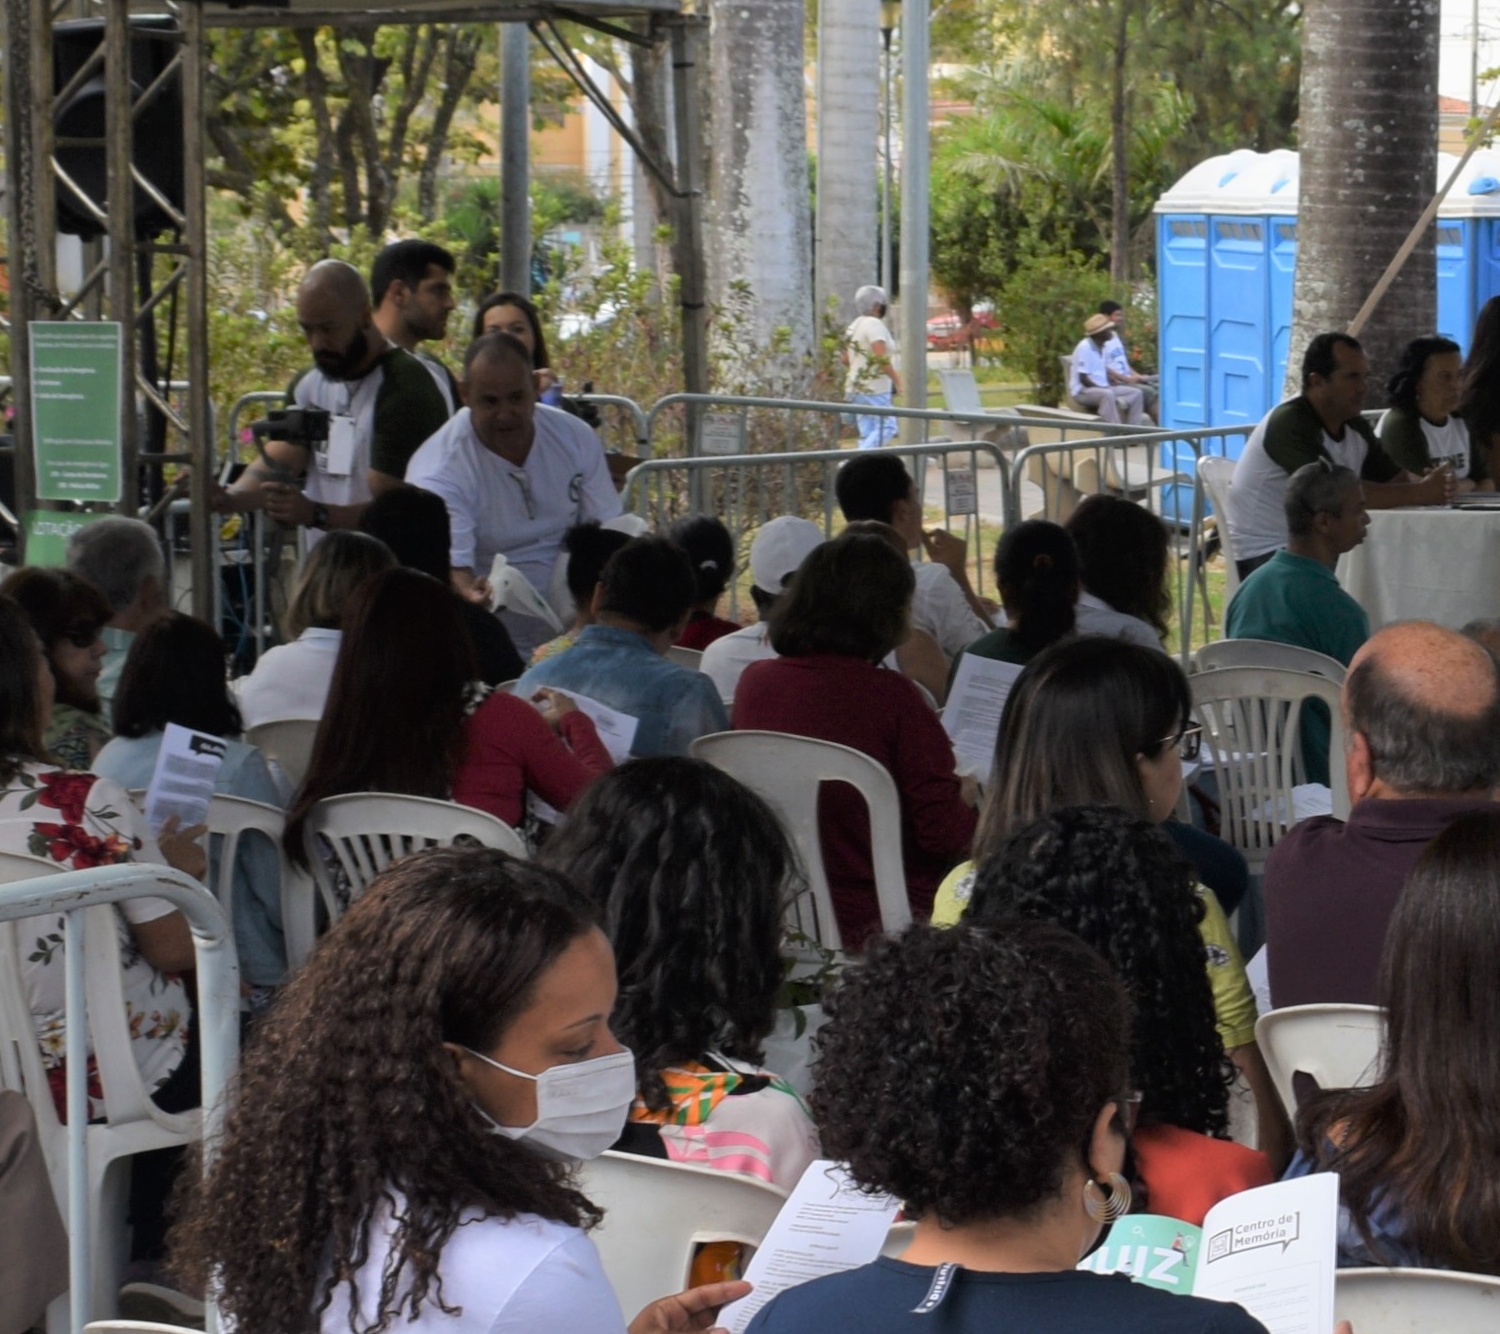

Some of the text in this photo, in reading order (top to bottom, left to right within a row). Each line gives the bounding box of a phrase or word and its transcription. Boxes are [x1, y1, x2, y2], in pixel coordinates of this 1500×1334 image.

[1235, 1214, 1293, 1235] Centro de
[1234, 1227, 1287, 1248] Memória
